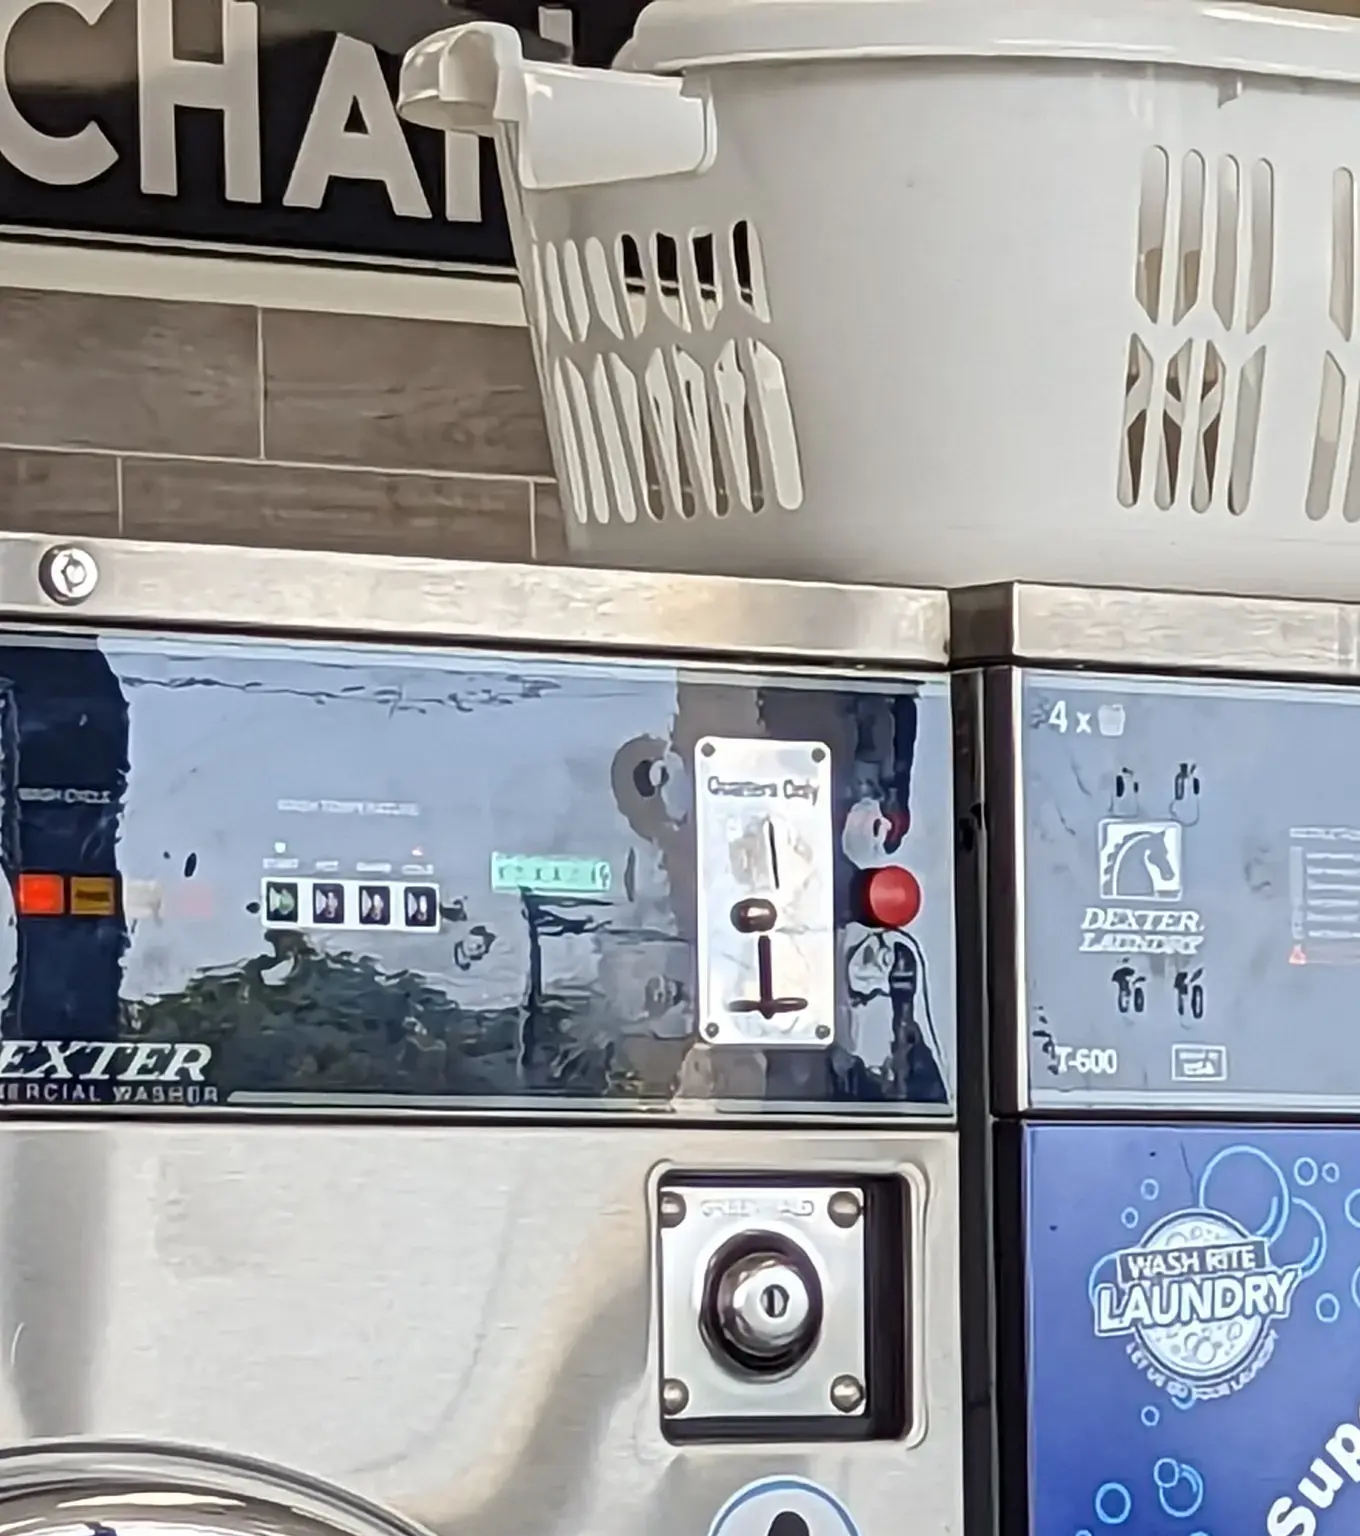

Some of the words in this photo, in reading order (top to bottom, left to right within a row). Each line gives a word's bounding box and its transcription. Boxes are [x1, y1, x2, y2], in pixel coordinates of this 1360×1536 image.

[1048, 700, 1068, 733] 4
[1076, 712, 1092, 733] x
[1080, 907, 1200, 932] DEXTER
[0, 1041, 212, 1082] EXTER
[1055, 1045, 1118, 1075] T-600
[0, 1083, 101, 1102] ERCIAL
[1128, 1249, 1200, 1279] WASH
[1206, 1245, 1257, 1272] RITE
[1098, 1269, 1297, 1333] LAUNDRY
